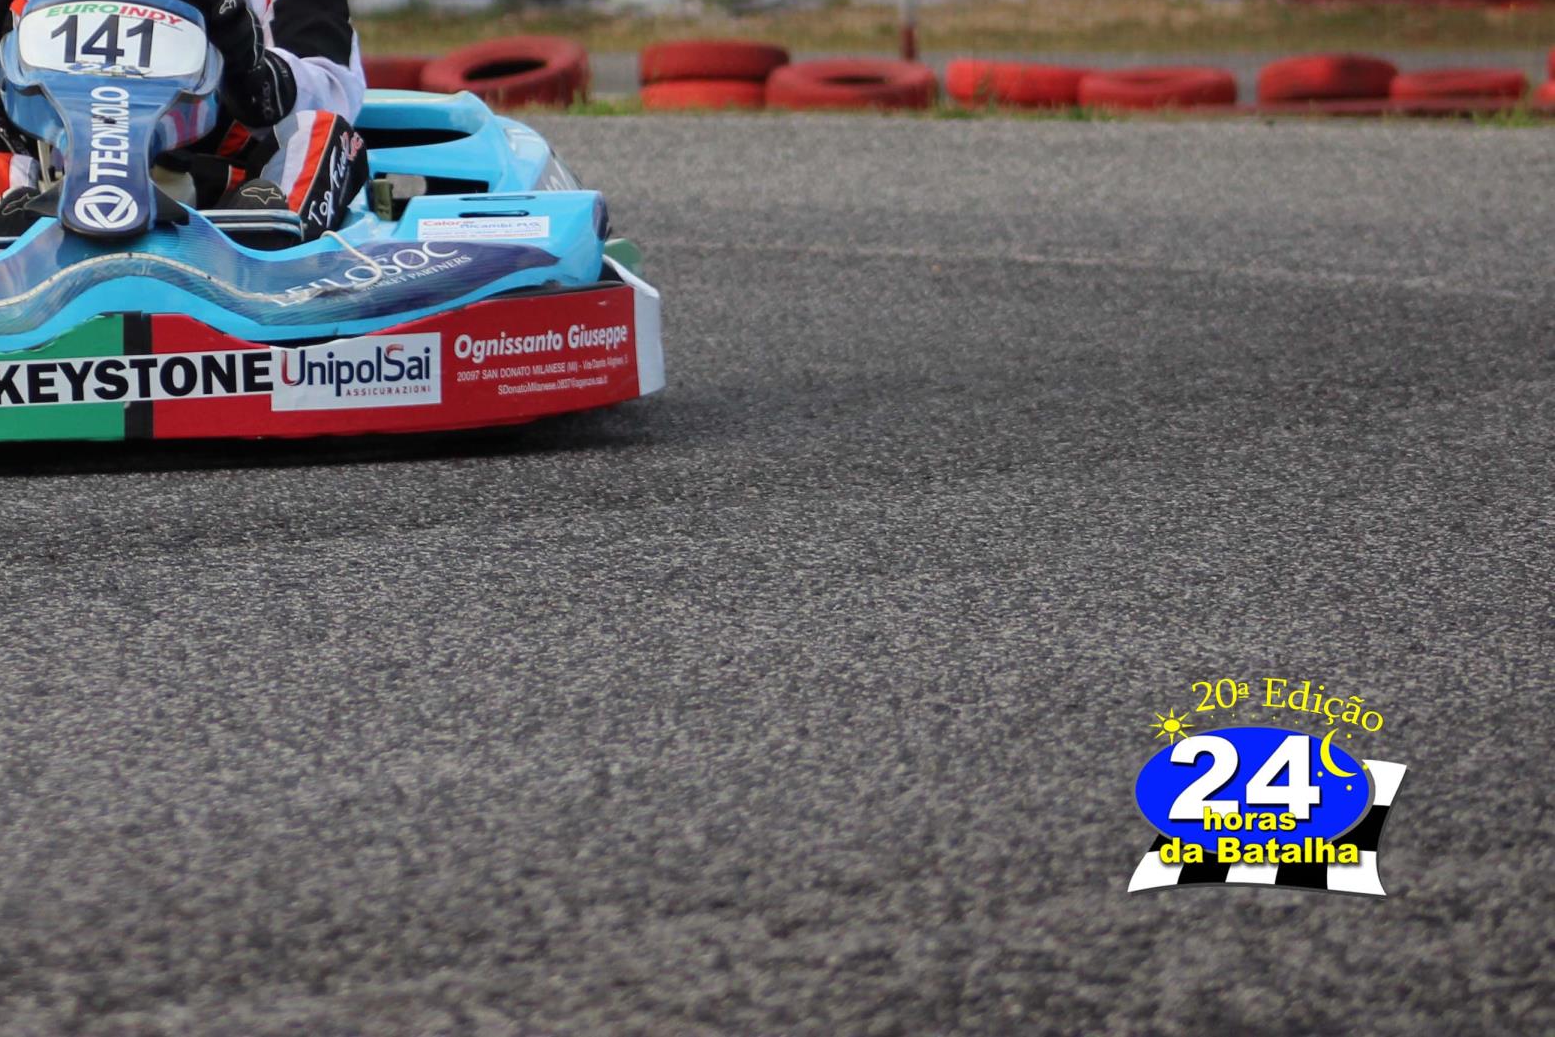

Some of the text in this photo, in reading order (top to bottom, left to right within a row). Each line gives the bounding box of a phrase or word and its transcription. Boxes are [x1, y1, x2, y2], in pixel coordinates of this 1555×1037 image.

[47, 3, 184, 25] EUROINDY
[50, 14, 154, 68] 141
[308, 191, 334, 228] Top
[408, 255, 473, 280] PARTNERS
[453, 324, 628, 364] Ognissanto Giuseppe
[281, 343, 431, 397] UnipolSai
[456, 369, 480, 382] 20097
[481, 368, 498, 380] SAN
[500, 365, 531, 378] DONATO
[532, 362, 565, 375] MILANESE
[345, 386, 432, 397] ASSICURAZIONI
